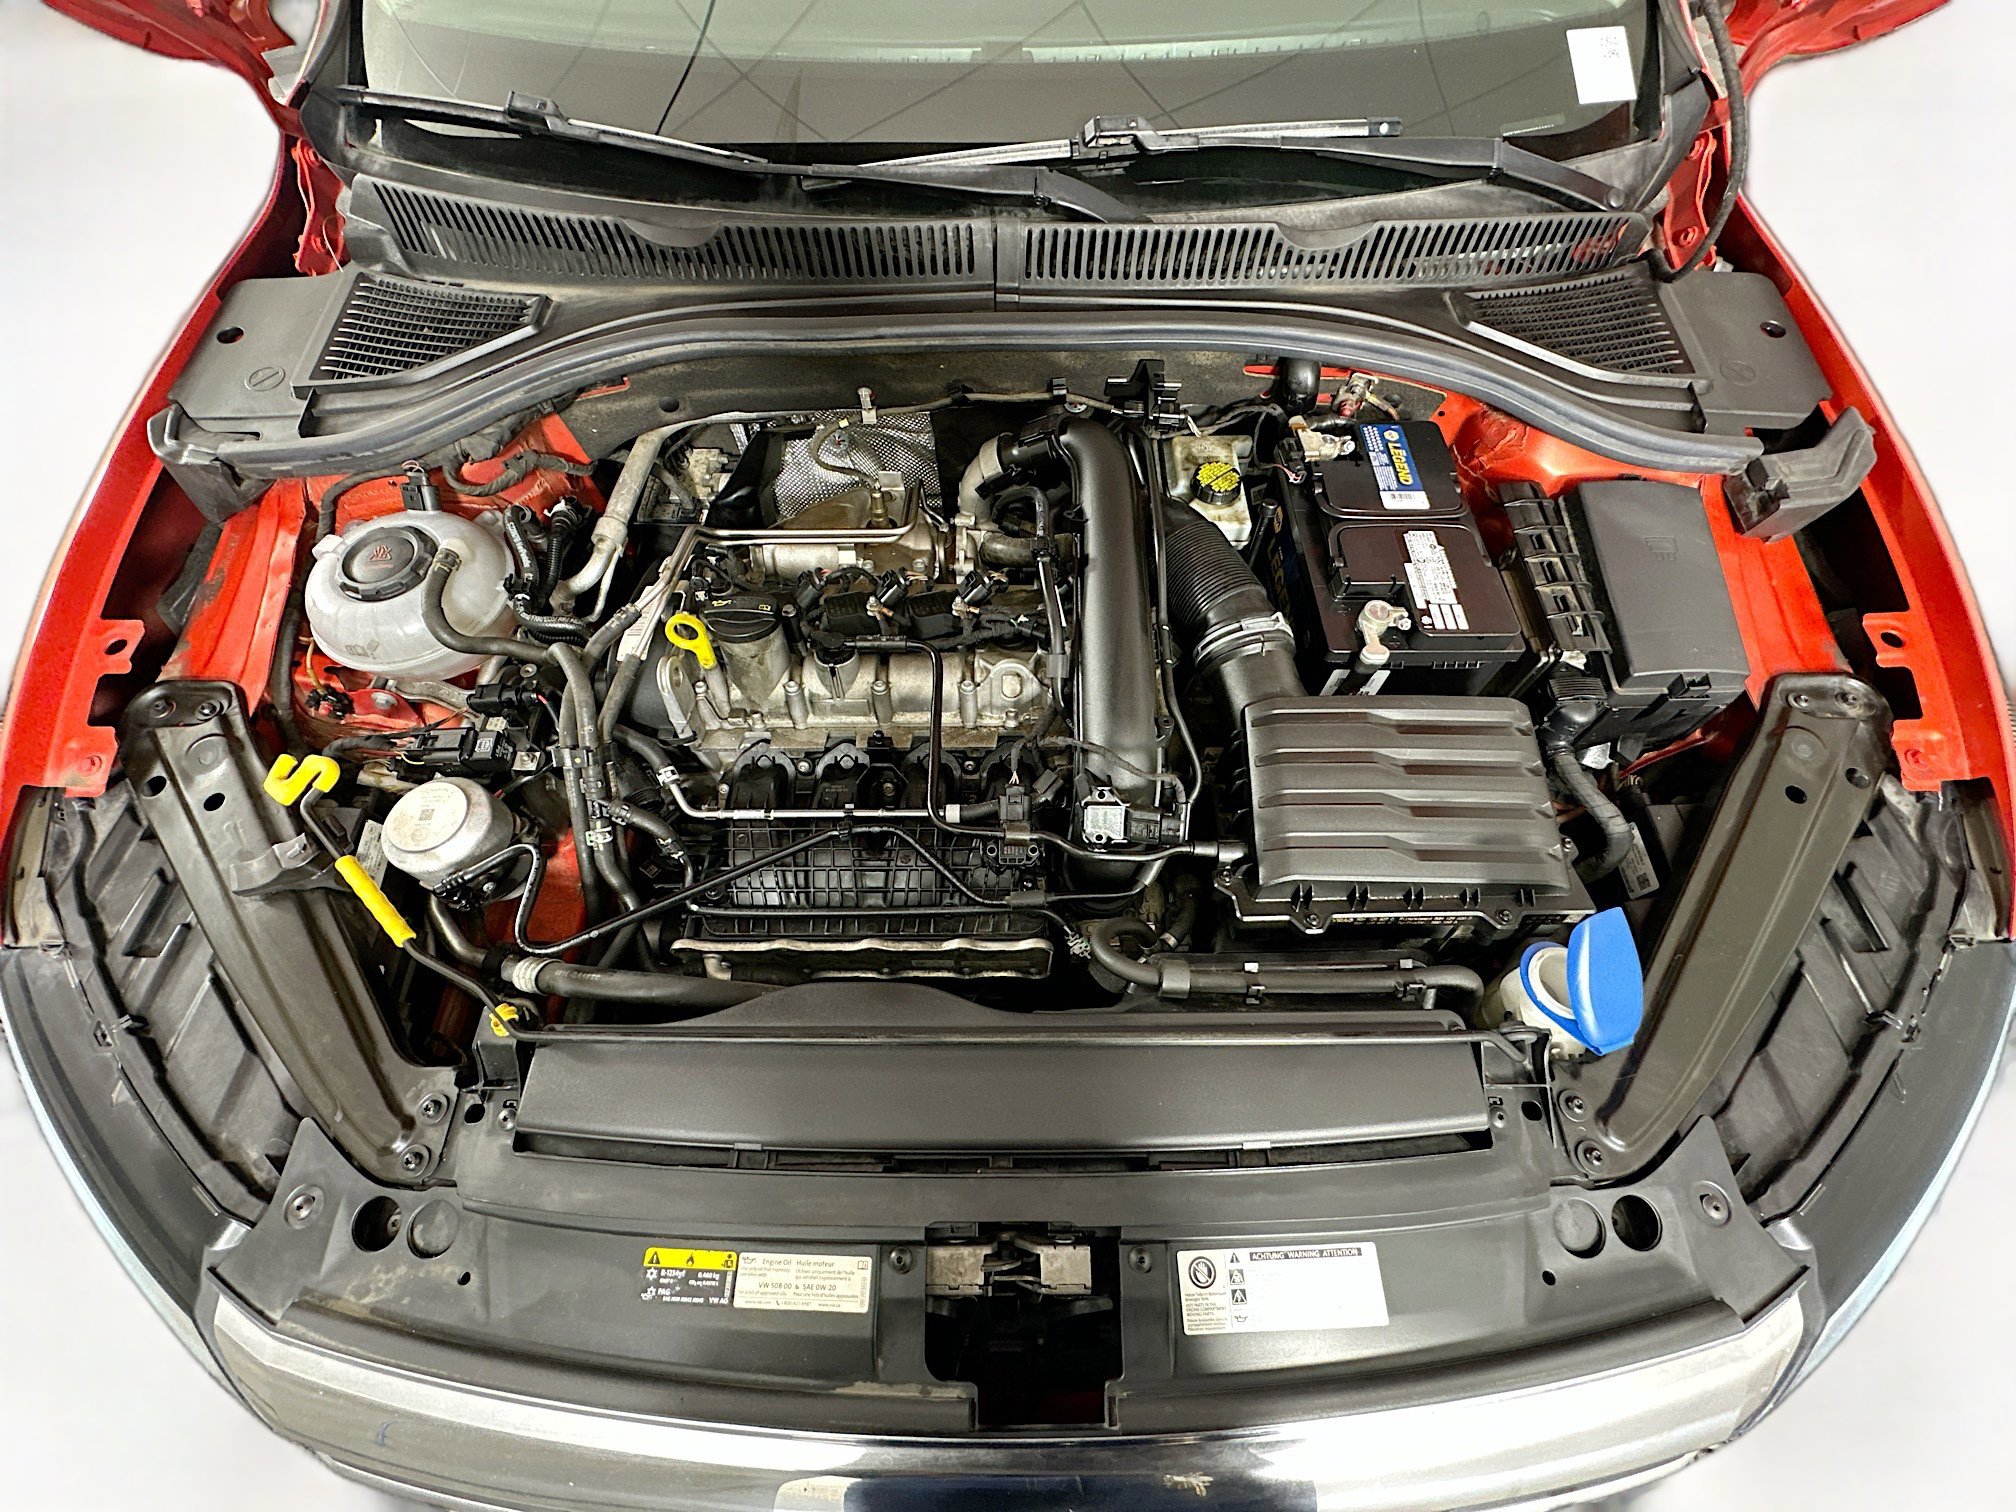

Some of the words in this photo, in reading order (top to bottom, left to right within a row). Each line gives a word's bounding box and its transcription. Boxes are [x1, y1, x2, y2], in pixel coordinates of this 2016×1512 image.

[1388, 442, 1413, 485] LEGEND
[1252, 1252, 1285, 1260] ACHTUNG
[1287, 1250, 1320, 1259] WARNING
[1322, 1248, 1358, 1257] ATTENTION
[762, 1258, 782, 1266] Engine
[783, 1282, 792, 1290] 00
[803, 1283, 814, 1291] SAE
